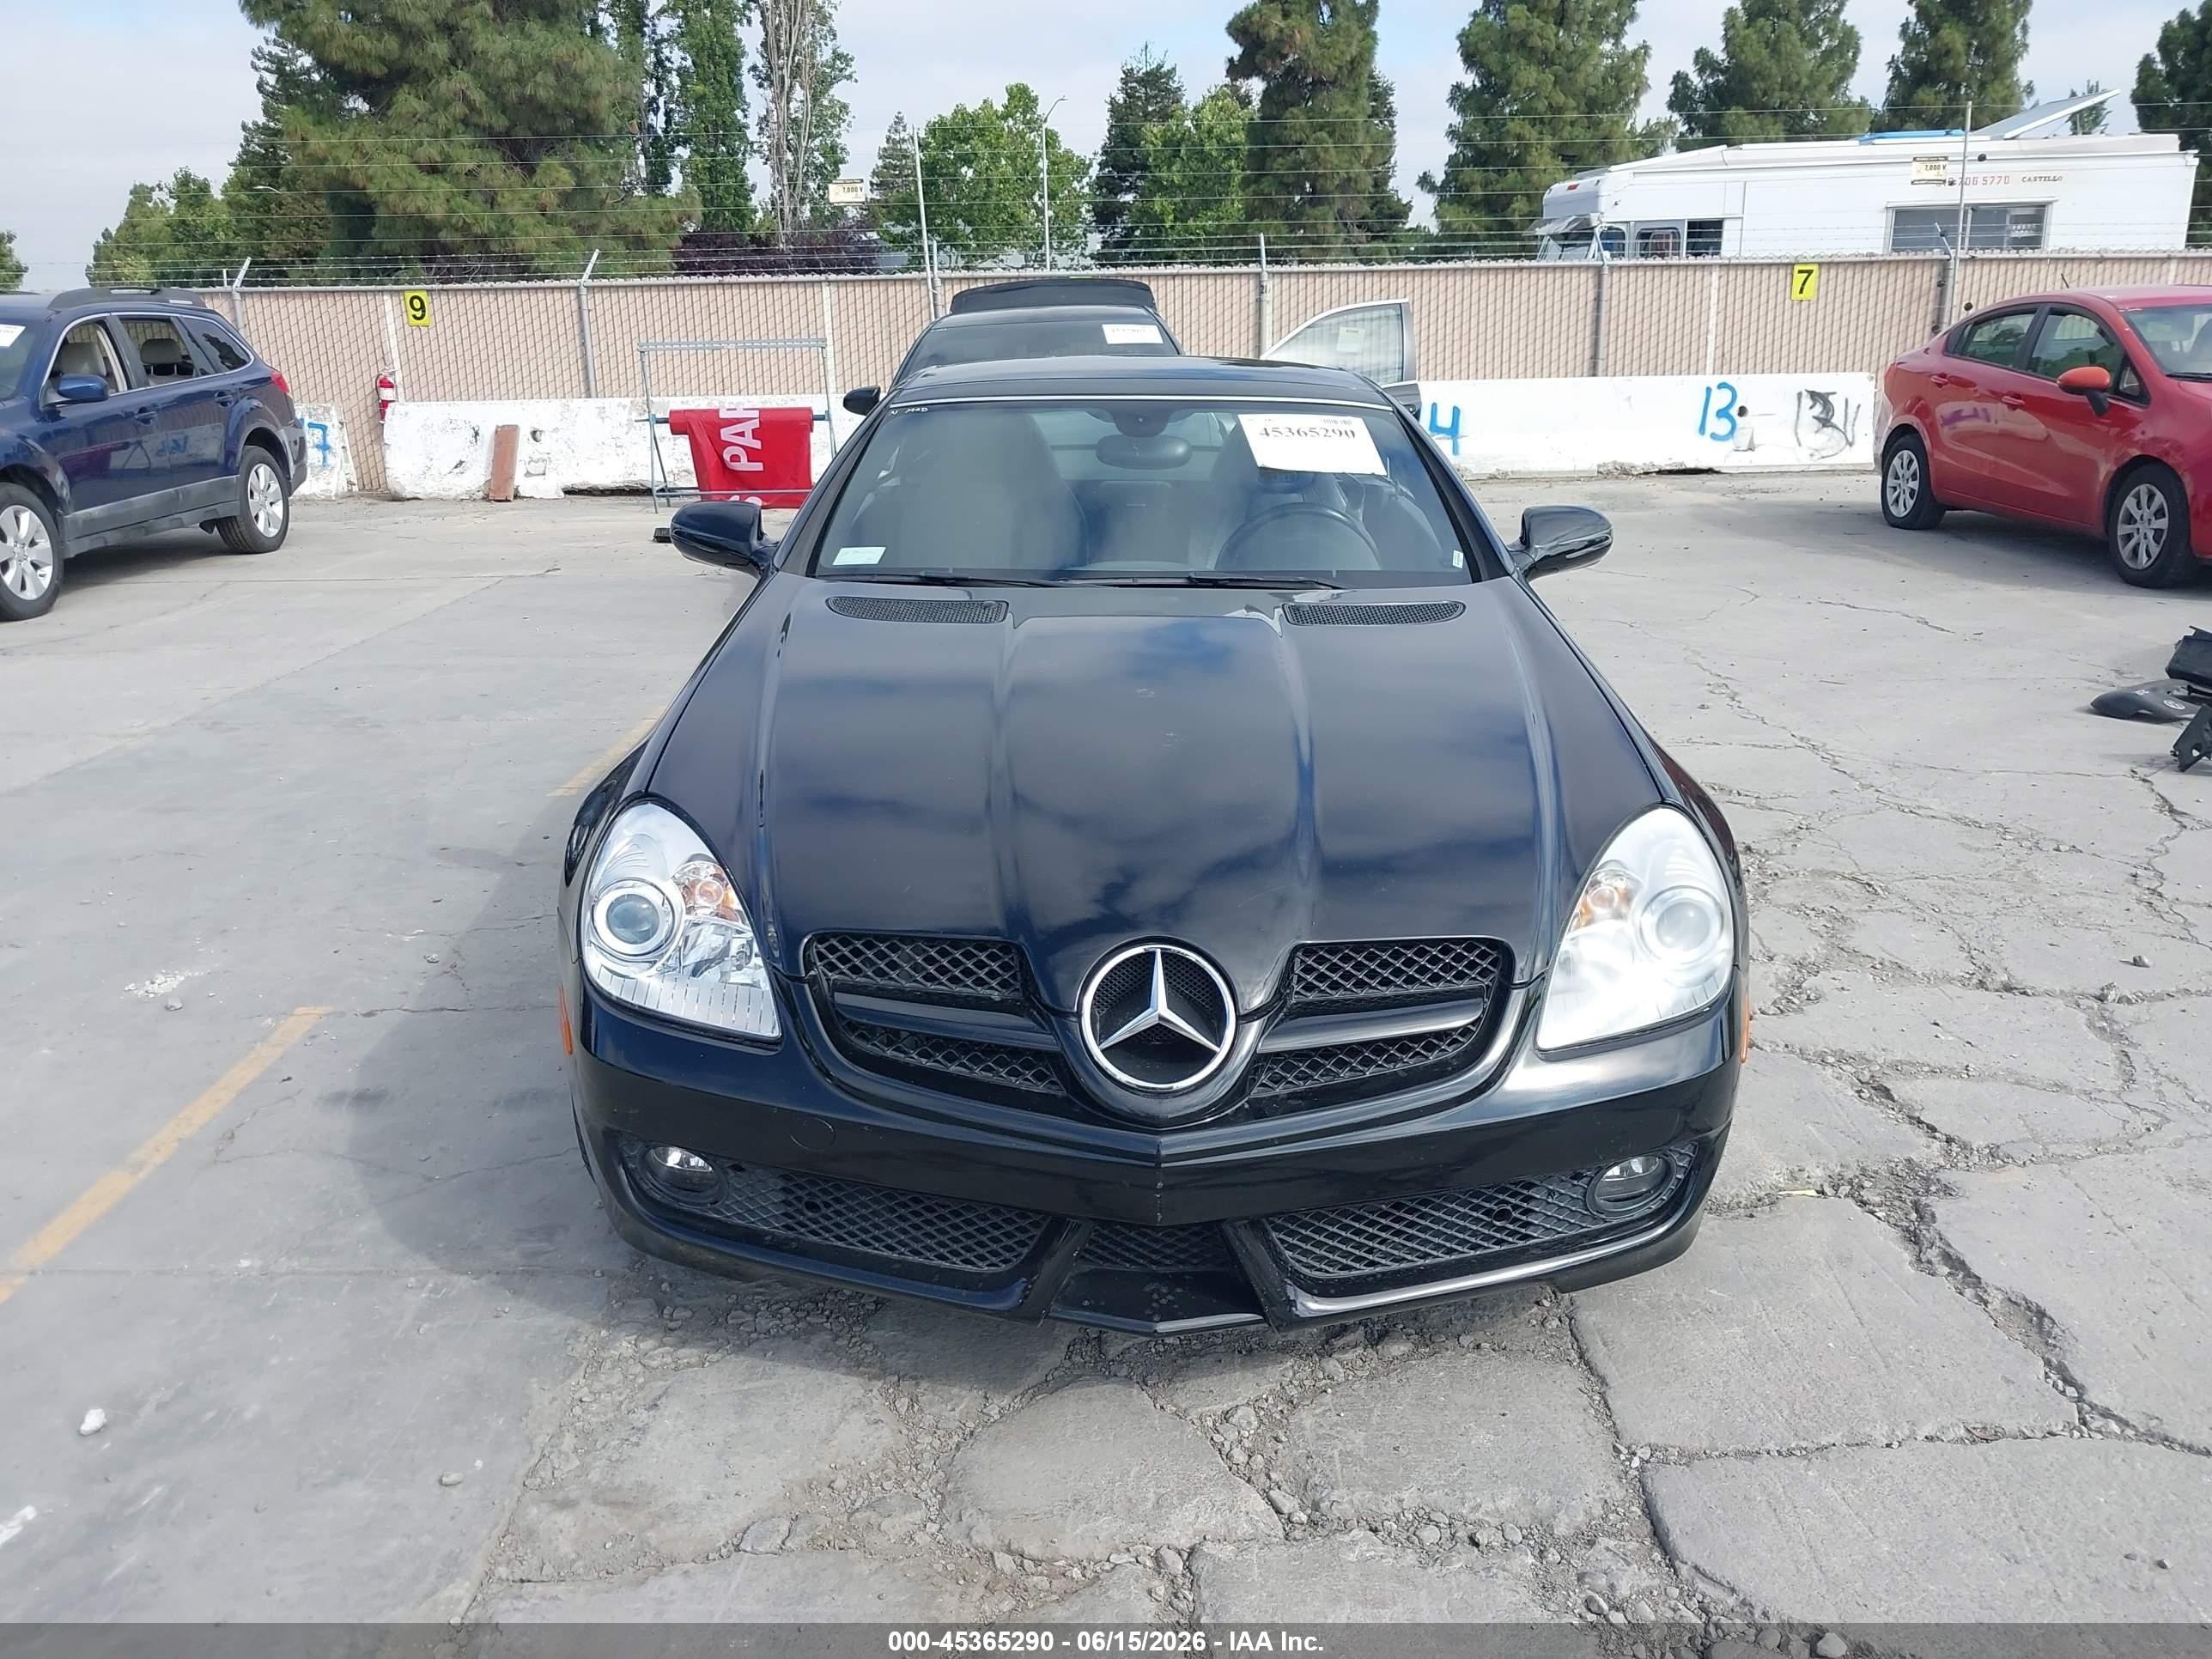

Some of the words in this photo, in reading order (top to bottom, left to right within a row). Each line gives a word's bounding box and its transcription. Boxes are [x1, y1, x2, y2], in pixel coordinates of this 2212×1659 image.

[1982, 175, 2009, 185] 5770
[1797, 269, 1814, 295] 7
[409, 295, 426, 321] 9
[1699, 381, 1737, 441] 13
[1260, 427, 1356, 439] 45365290
[1429, 402, 1461, 456] 4
